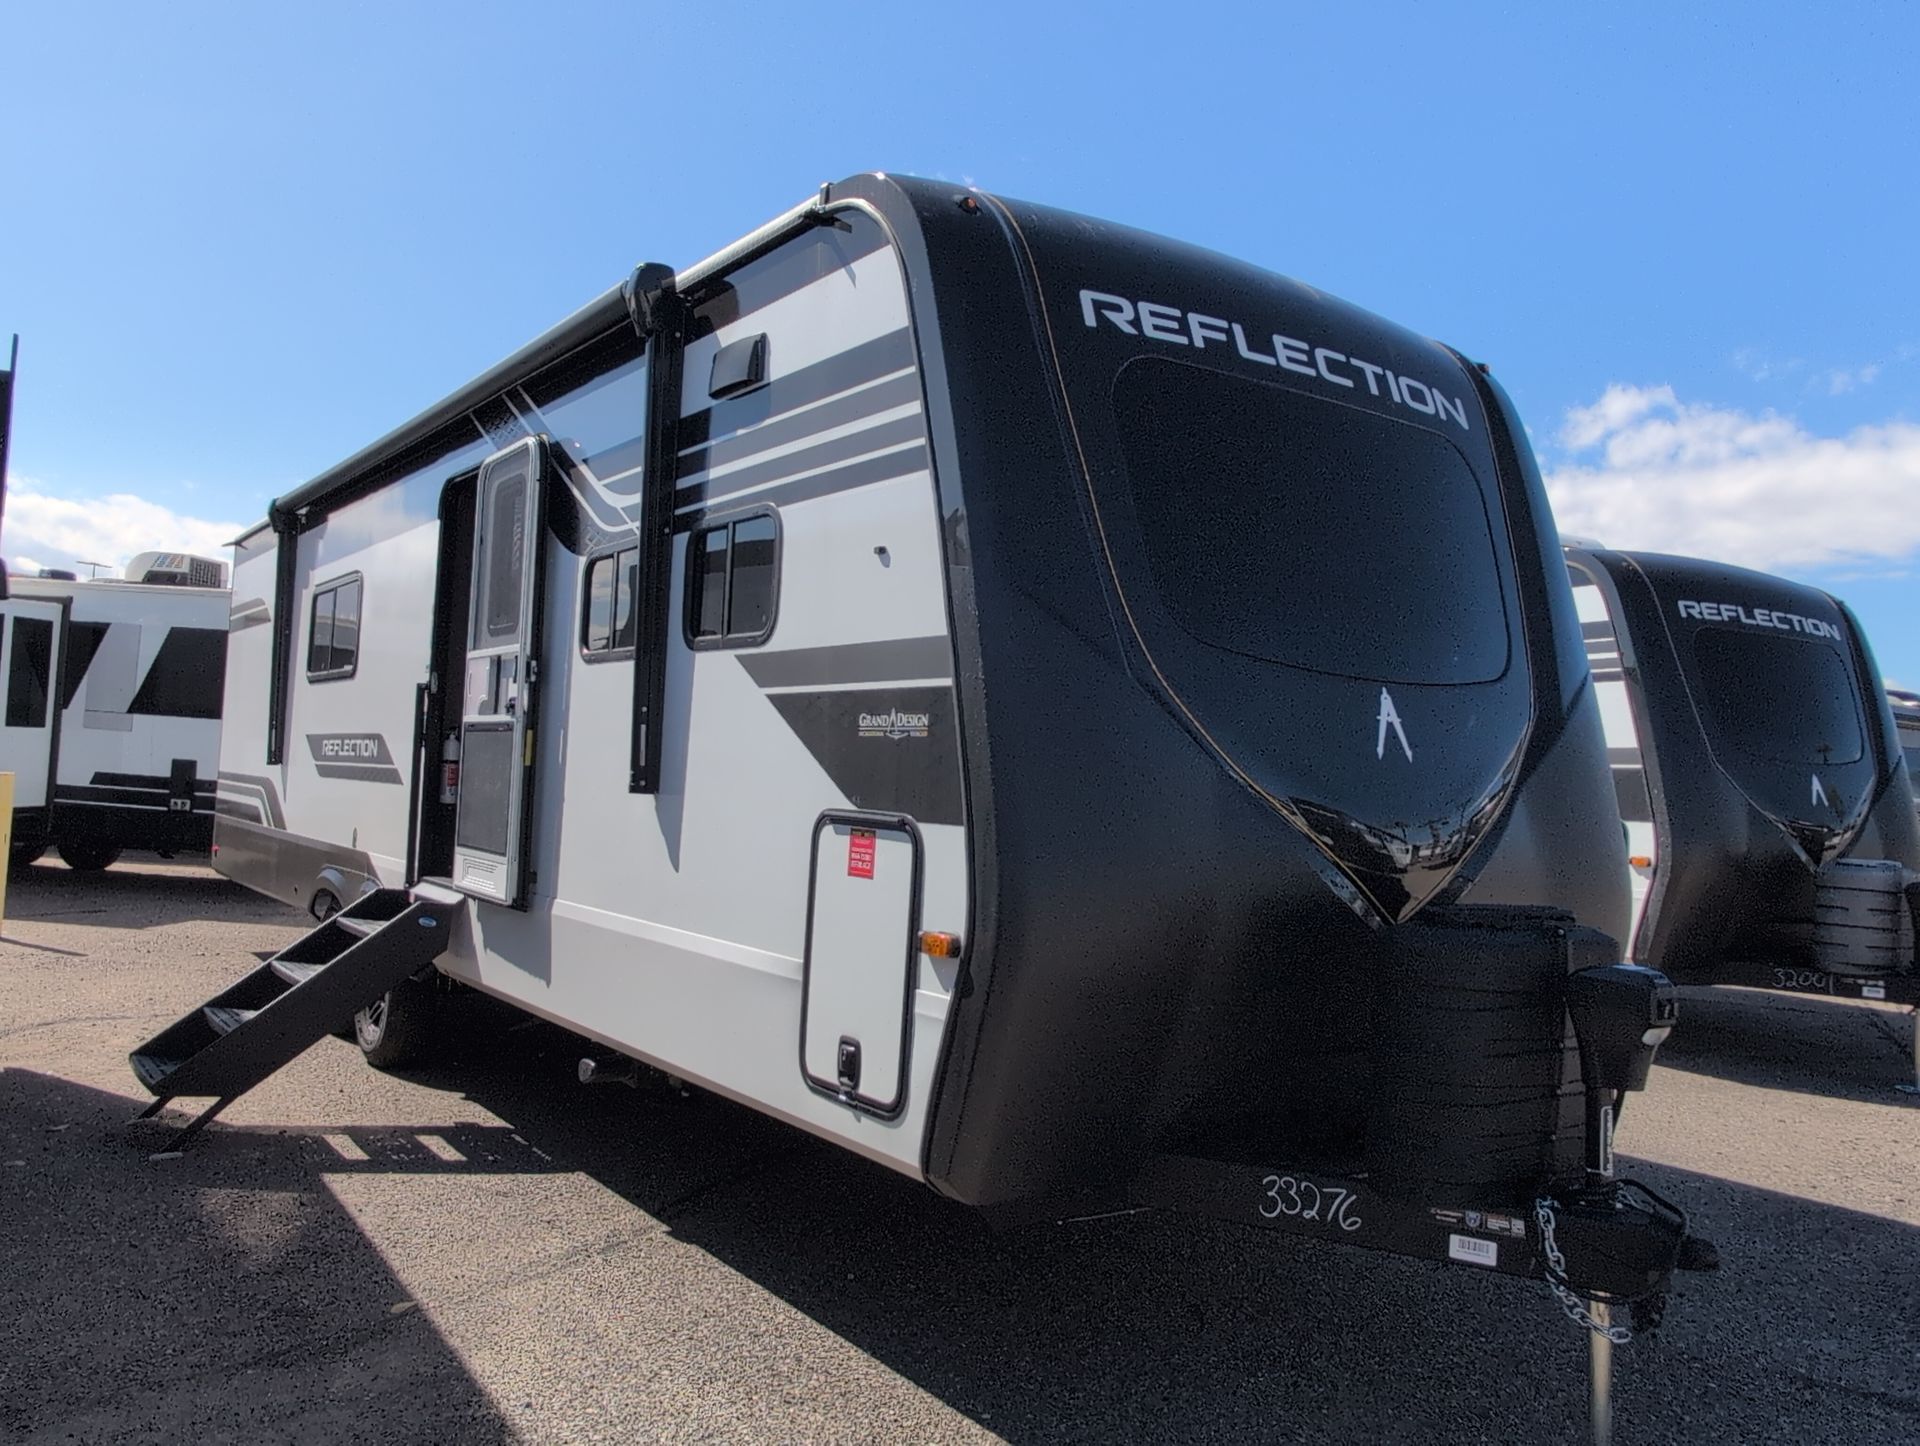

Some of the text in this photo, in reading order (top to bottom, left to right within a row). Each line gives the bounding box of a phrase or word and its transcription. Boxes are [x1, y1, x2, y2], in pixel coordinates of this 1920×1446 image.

[1079, 289, 1470, 431] REFLECTION
[1677, 600, 1842, 641] REFLECTION
[859, 712, 929, 727] GRAND DESIGN
[321, 739, 378, 757] REFLECTION
[1259, 1175, 1362, 1231] 33276
